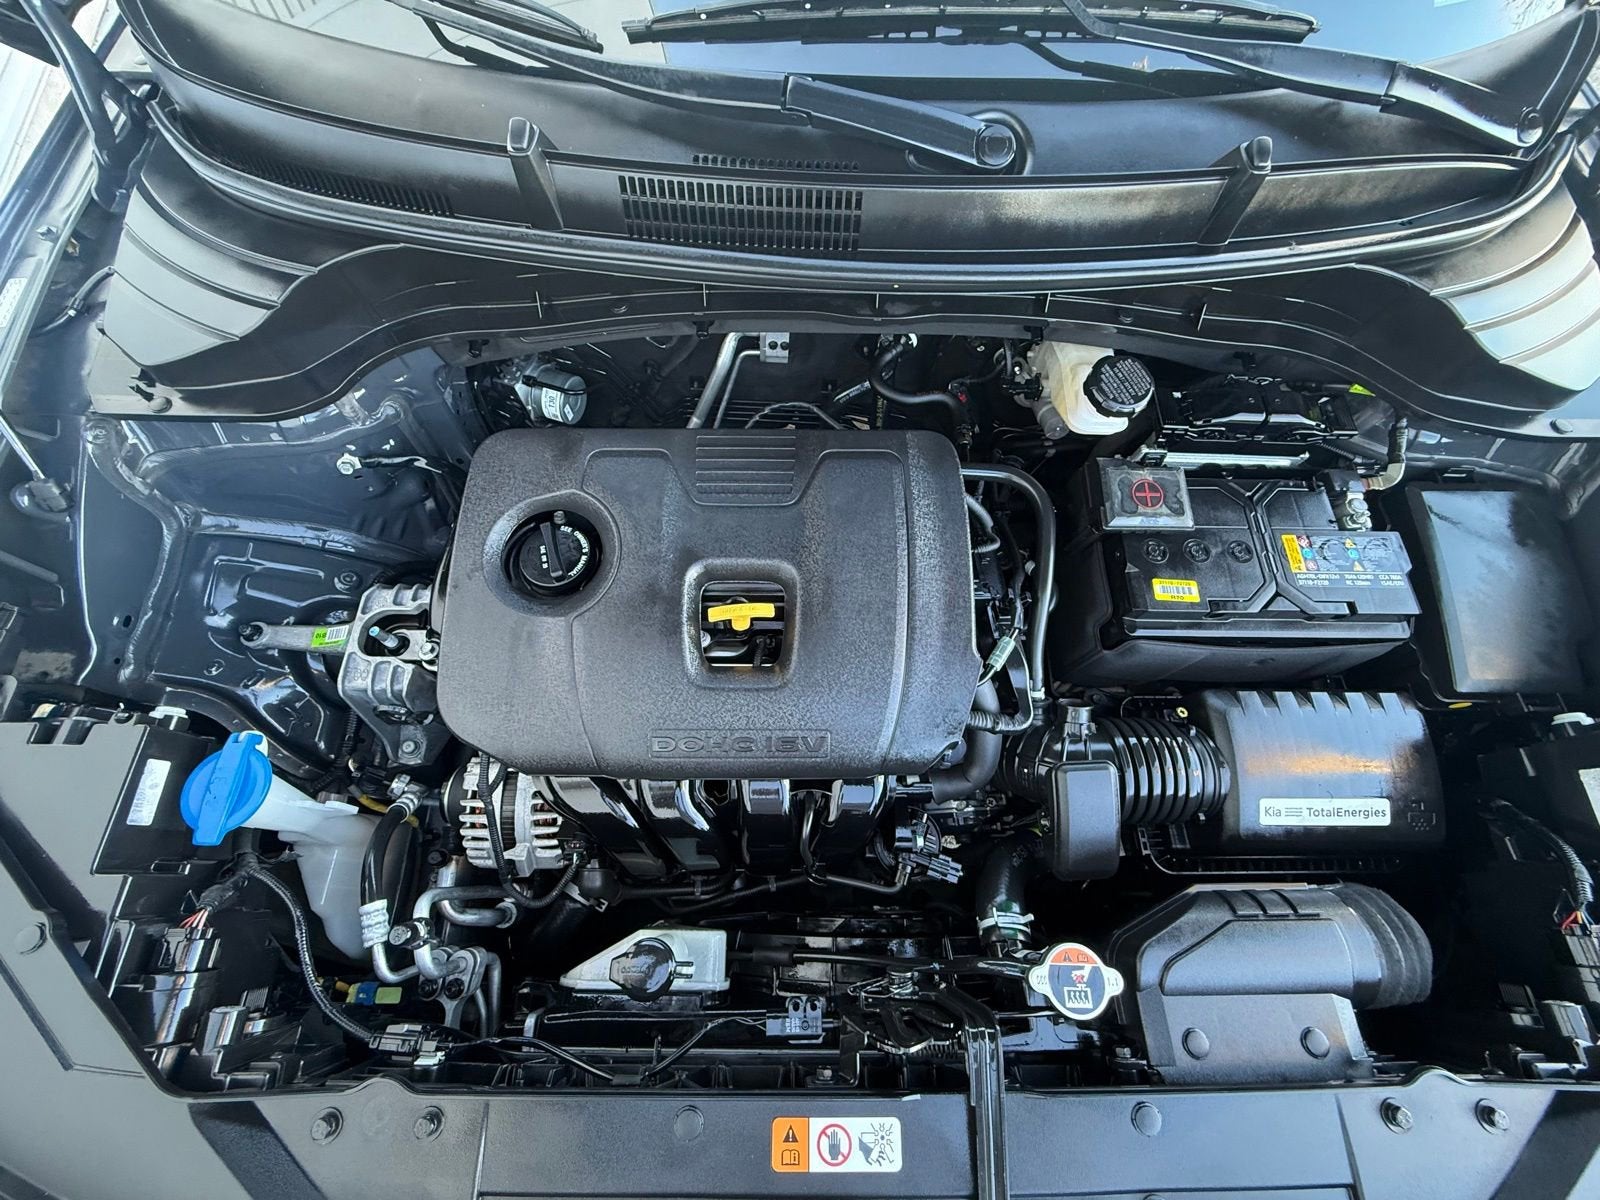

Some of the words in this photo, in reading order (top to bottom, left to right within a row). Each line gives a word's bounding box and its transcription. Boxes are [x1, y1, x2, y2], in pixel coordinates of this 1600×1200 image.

[560, 525, 573, 533] SEE
[568, 555, 588, 577] MANUAL
[651, 736, 754, 752] DOHC
[766, 736, 827, 752] 16V
[1264, 806, 1282, 817] Kia
[1306, 806, 1387, 819] TotalEnergies
